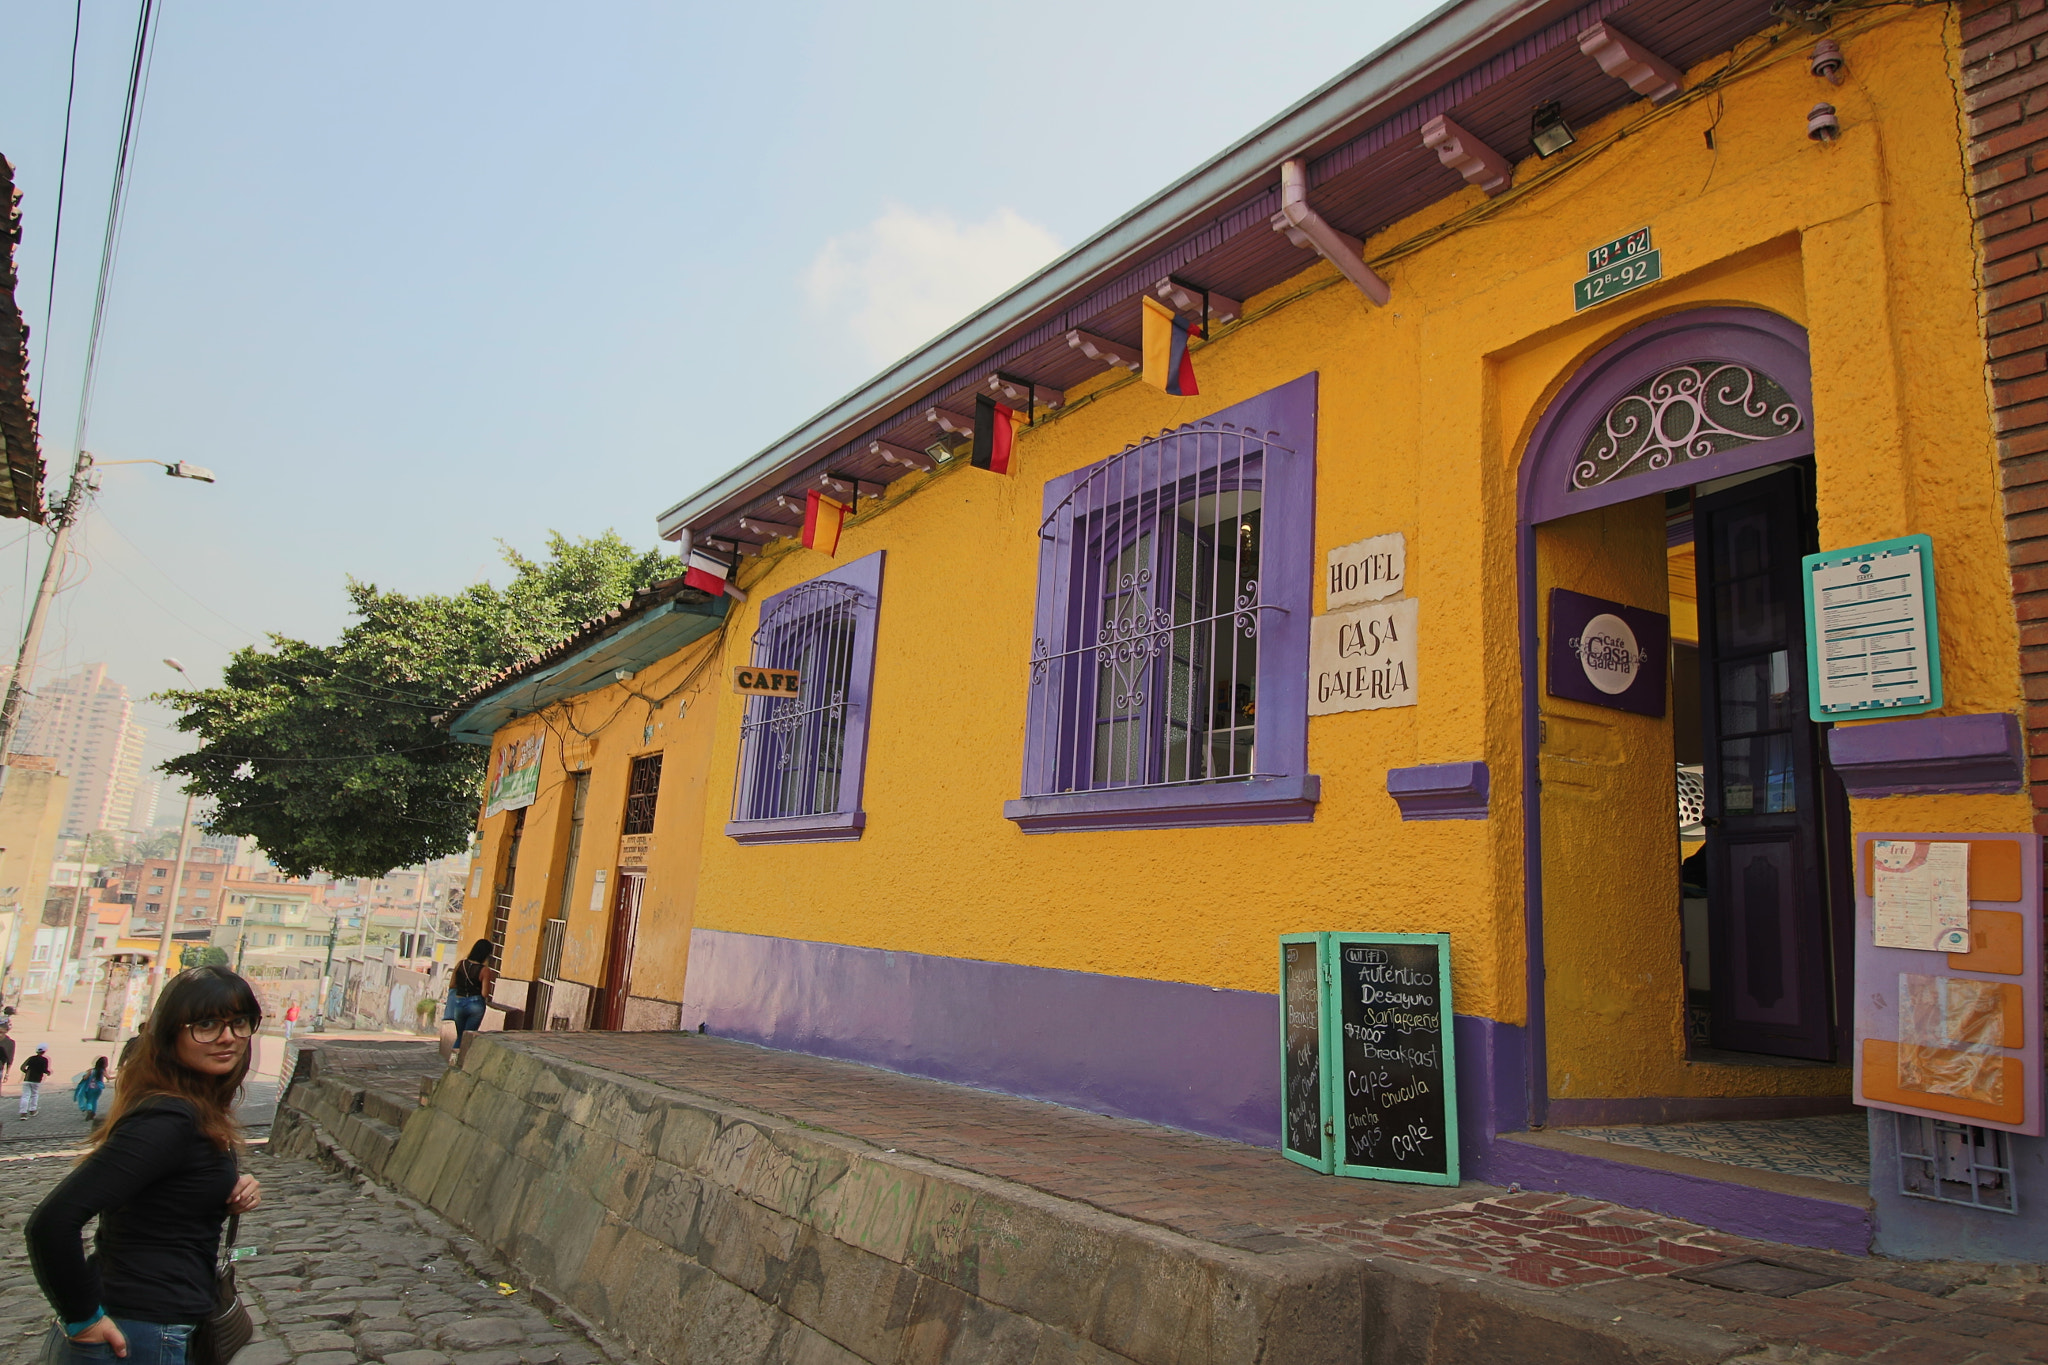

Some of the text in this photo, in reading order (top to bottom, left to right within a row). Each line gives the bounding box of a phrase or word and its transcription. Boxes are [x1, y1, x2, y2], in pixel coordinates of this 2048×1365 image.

[1330, 553, 1400, 595] HOTEL
[1338, 614, 1398, 659] CASA
[1588, 636, 1629, 664] Casa
[1603, 635, 1625, 648] Café
[738, 671, 798, 692] CAFE
[1358, 964, 1433, 986] Auténtico
[1361, 984, 1433, 1010] Desayuno
[1363, 1043, 1438, 1070] Breakfast
[1348, 1065, 1393, 1101] Café
[1391, 1117, 1434, 1161] Café
